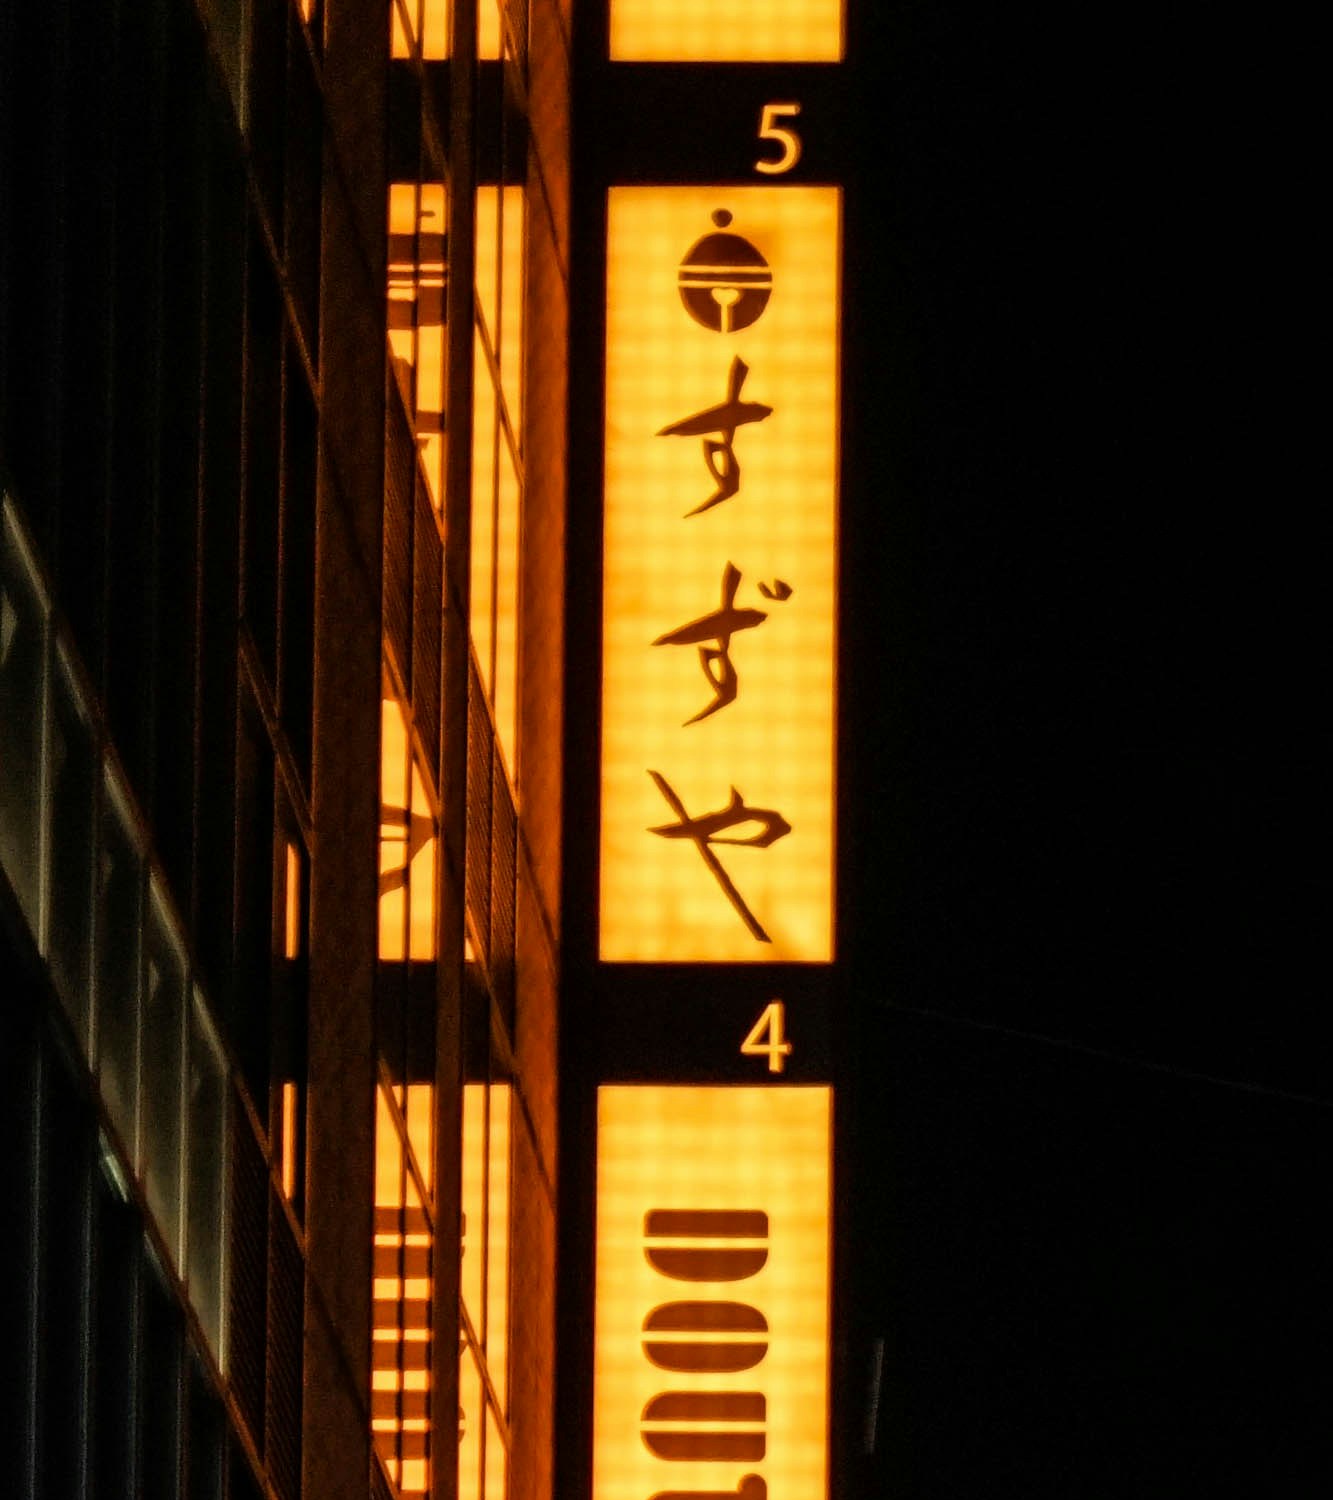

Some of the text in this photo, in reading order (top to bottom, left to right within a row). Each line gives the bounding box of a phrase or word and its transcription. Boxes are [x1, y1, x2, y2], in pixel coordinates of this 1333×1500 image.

[754, 104, 799, 174] 5
[647, 355, 794, 944] すずや
[741, 1003, 792, 1073] 4
